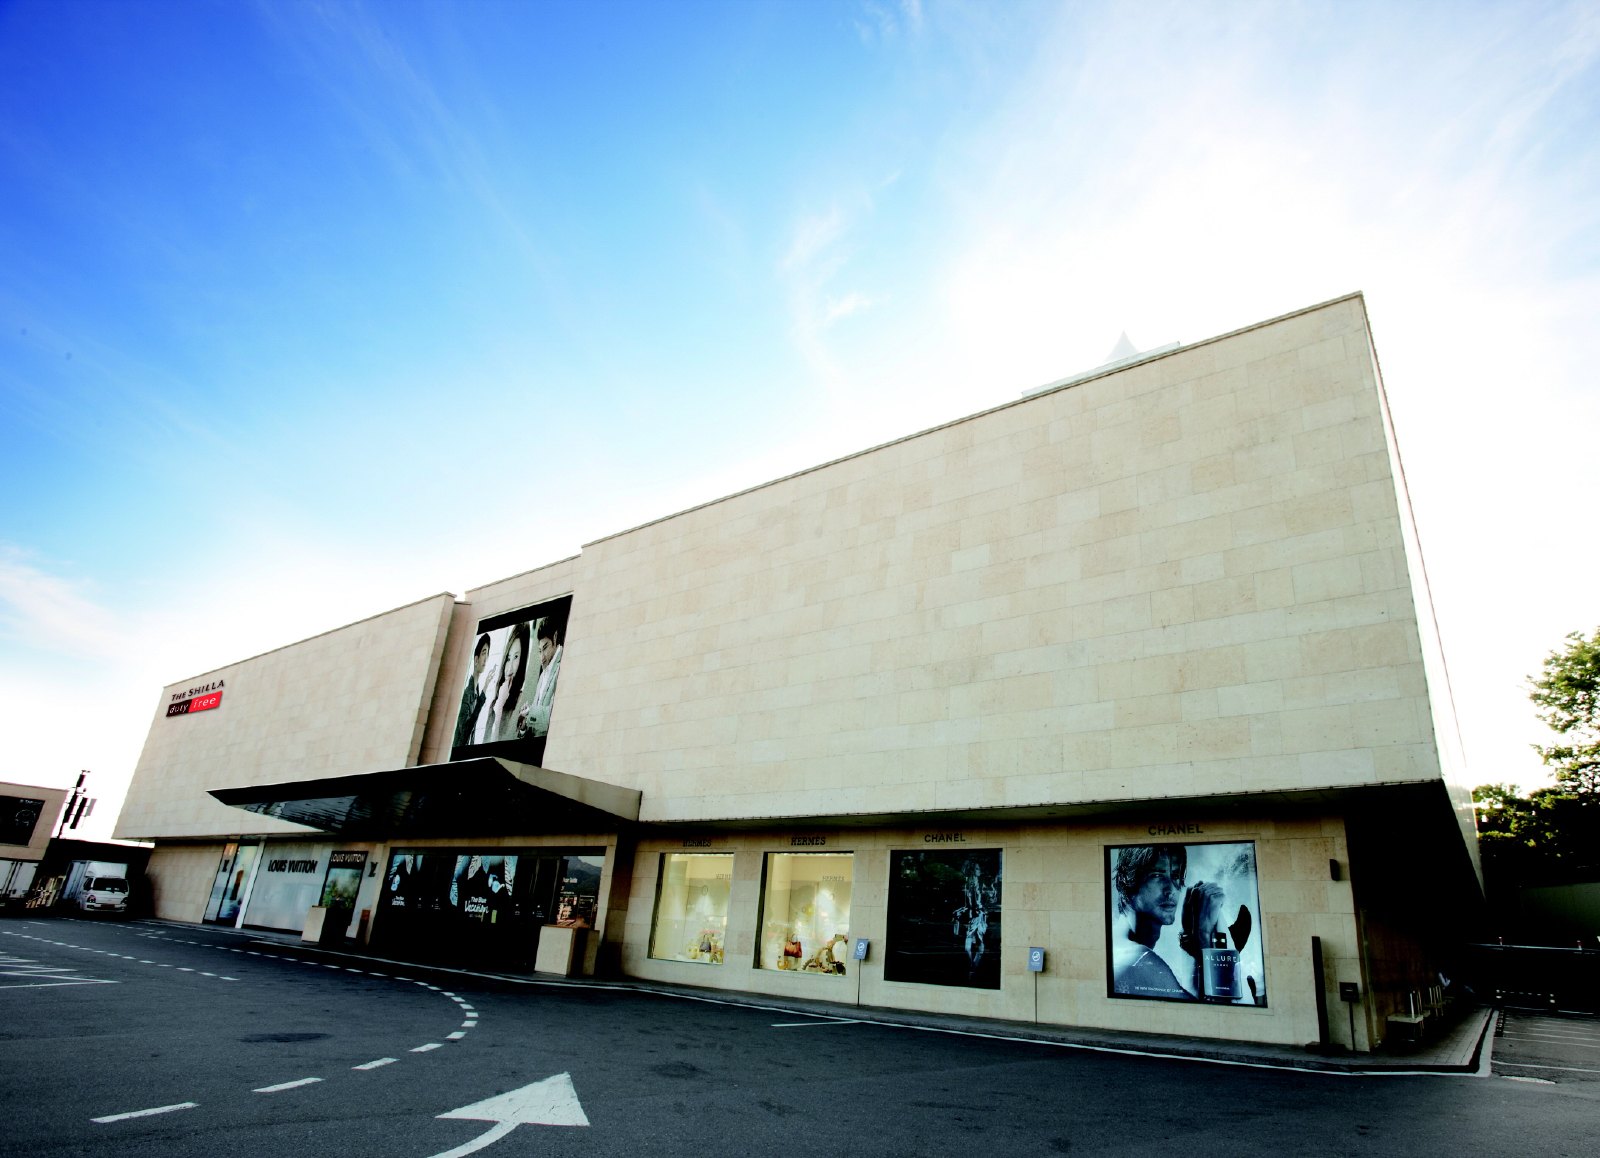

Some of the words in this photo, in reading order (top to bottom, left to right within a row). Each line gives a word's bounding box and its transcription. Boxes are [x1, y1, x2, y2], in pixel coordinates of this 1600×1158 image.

[172, 692, 186, 701] THE
[188, 680, 225, 697] SHILLA
[169, 704, 188, 714] duty
[193, 697, 216, 708] free
[1148, 824, 1204, 836] CHANEL
[924, 832, 966, 843] CHANEL
[331, 854, 345, 862] LOUIS
[345, 854, 366, 863] VUITTON
[268, 860, 288, 873] LOUIS
[288, 860, 318, 874] VUITTON
[1205, 955, 1237, 963] ALLURE
